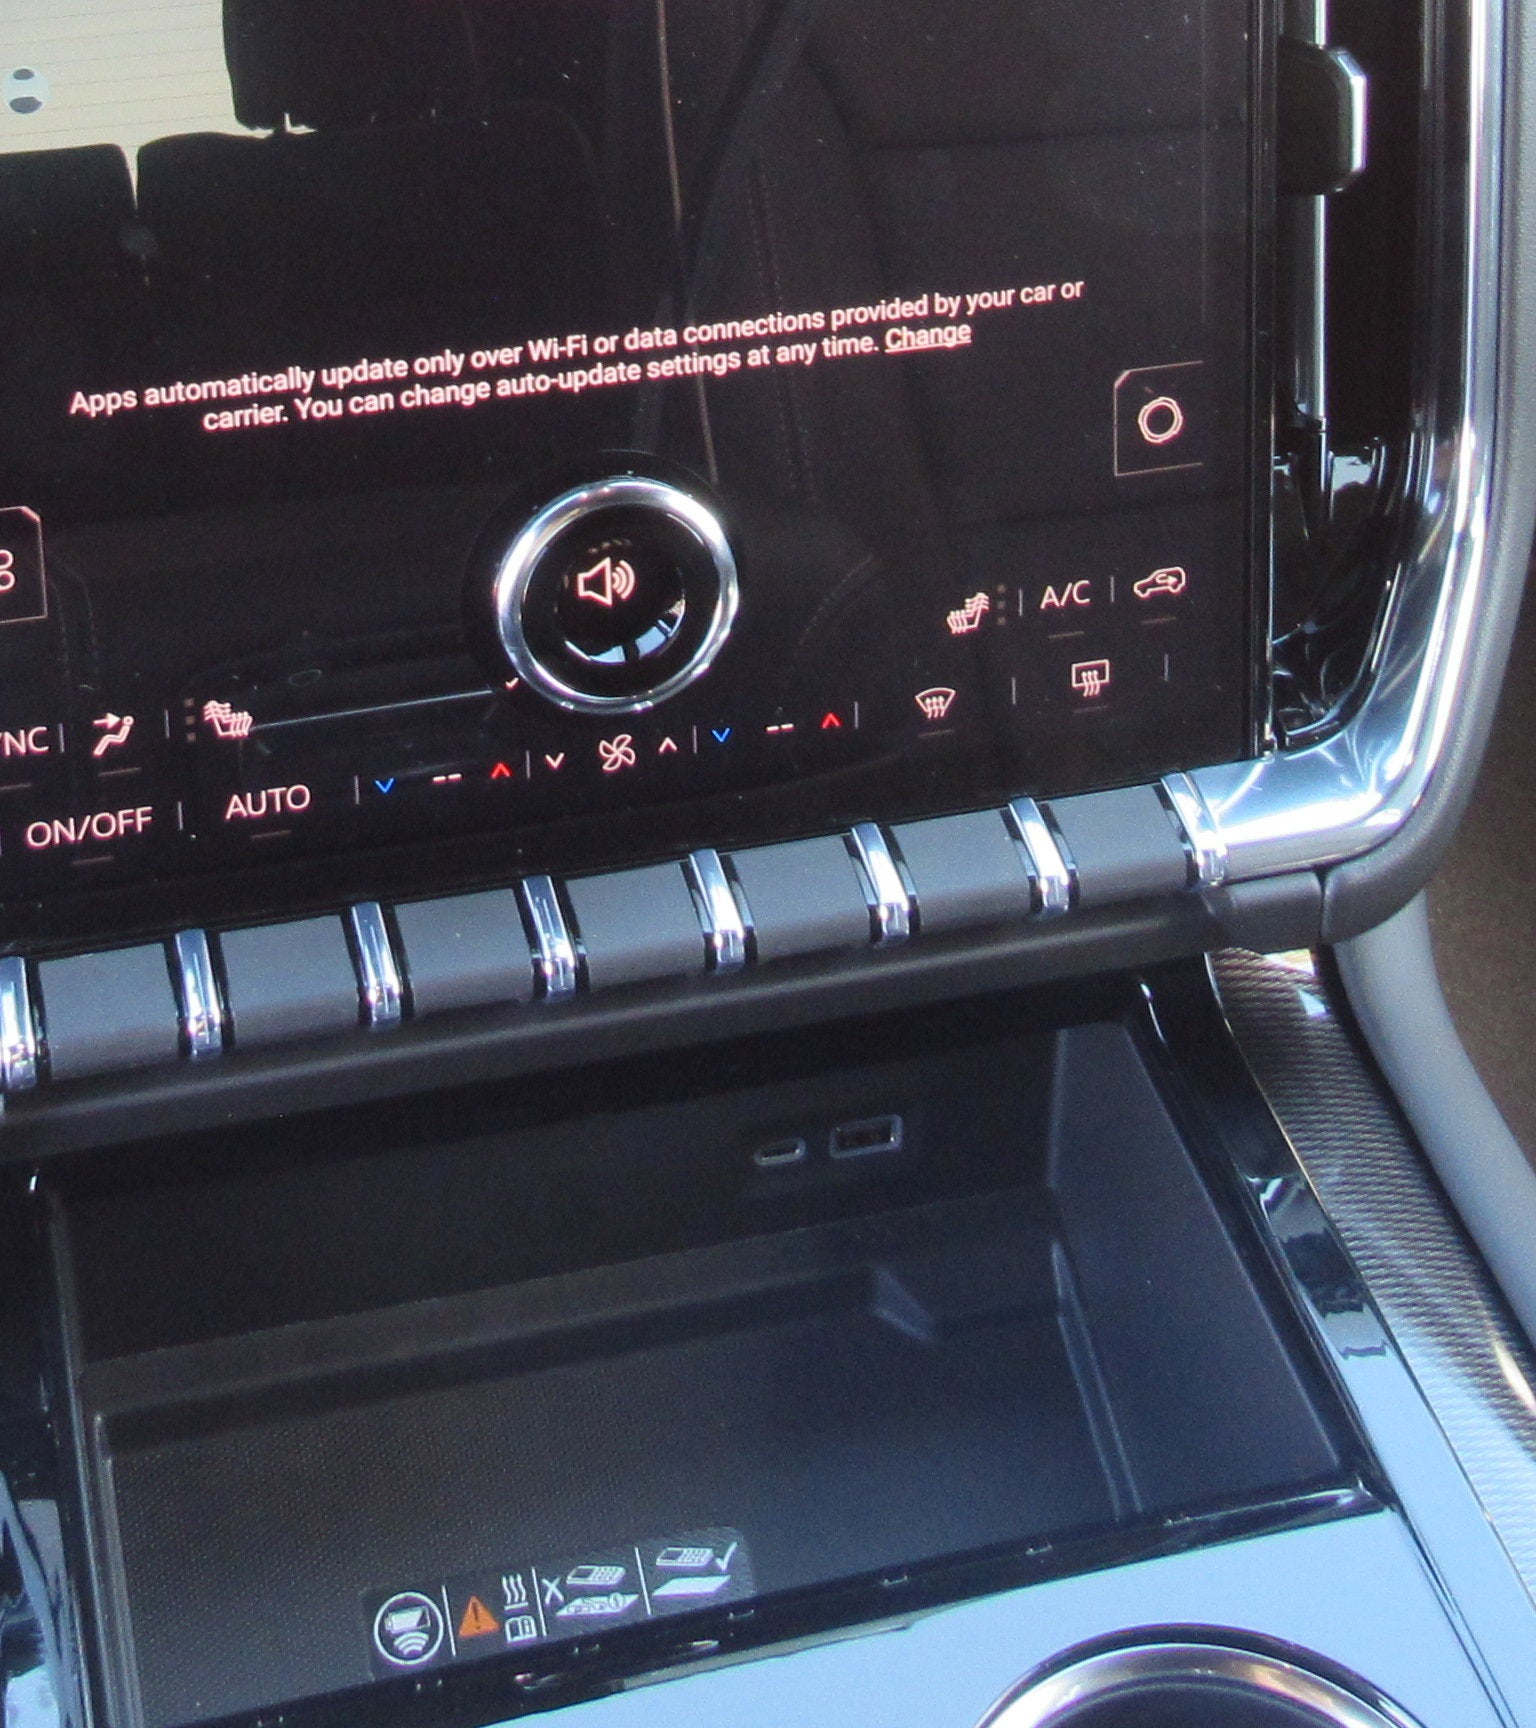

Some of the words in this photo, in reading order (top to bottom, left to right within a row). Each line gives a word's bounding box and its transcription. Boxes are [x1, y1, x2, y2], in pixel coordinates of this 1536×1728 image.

[69, 390, 139, 419] Apps
[144, 365, 315, 407] automatically
[321, 357, 409, 391] update
[414, 348, 466, 378] only
[470, 346, 524, 371] over
[527, 333, 589, 362] Wi-Fi
[593, 334, 620, 356] or
[624, 325, 679, 352] data
[683, 309, 826, 346] connections
[830, 294, 930, 333] provided
[934, 291, 963, 319] by
[965, 286, 1016, 316] your
[1020, 284, 1056, 305] car
[1059, 280, 1086, 301] or
[202, 403, 289, 432] carrier.
[293, 397, 344, 422] You
[348, 391, 395, 415] can
[400, 375, 492, 408] change
[496, 362, 642, 398] auto-update
[646, 348, 742, 383] settings
[746, 344, 772, 368] at
[775, 338, 818, 366] any
[821, 331, 880, 359] time.
[884, 321, 973, 355] Change
[1039, 578, 1091, 612] A/C
[224, 782, 312, 821] AUTO
[25, 805, 154, 849] ON/OFF
